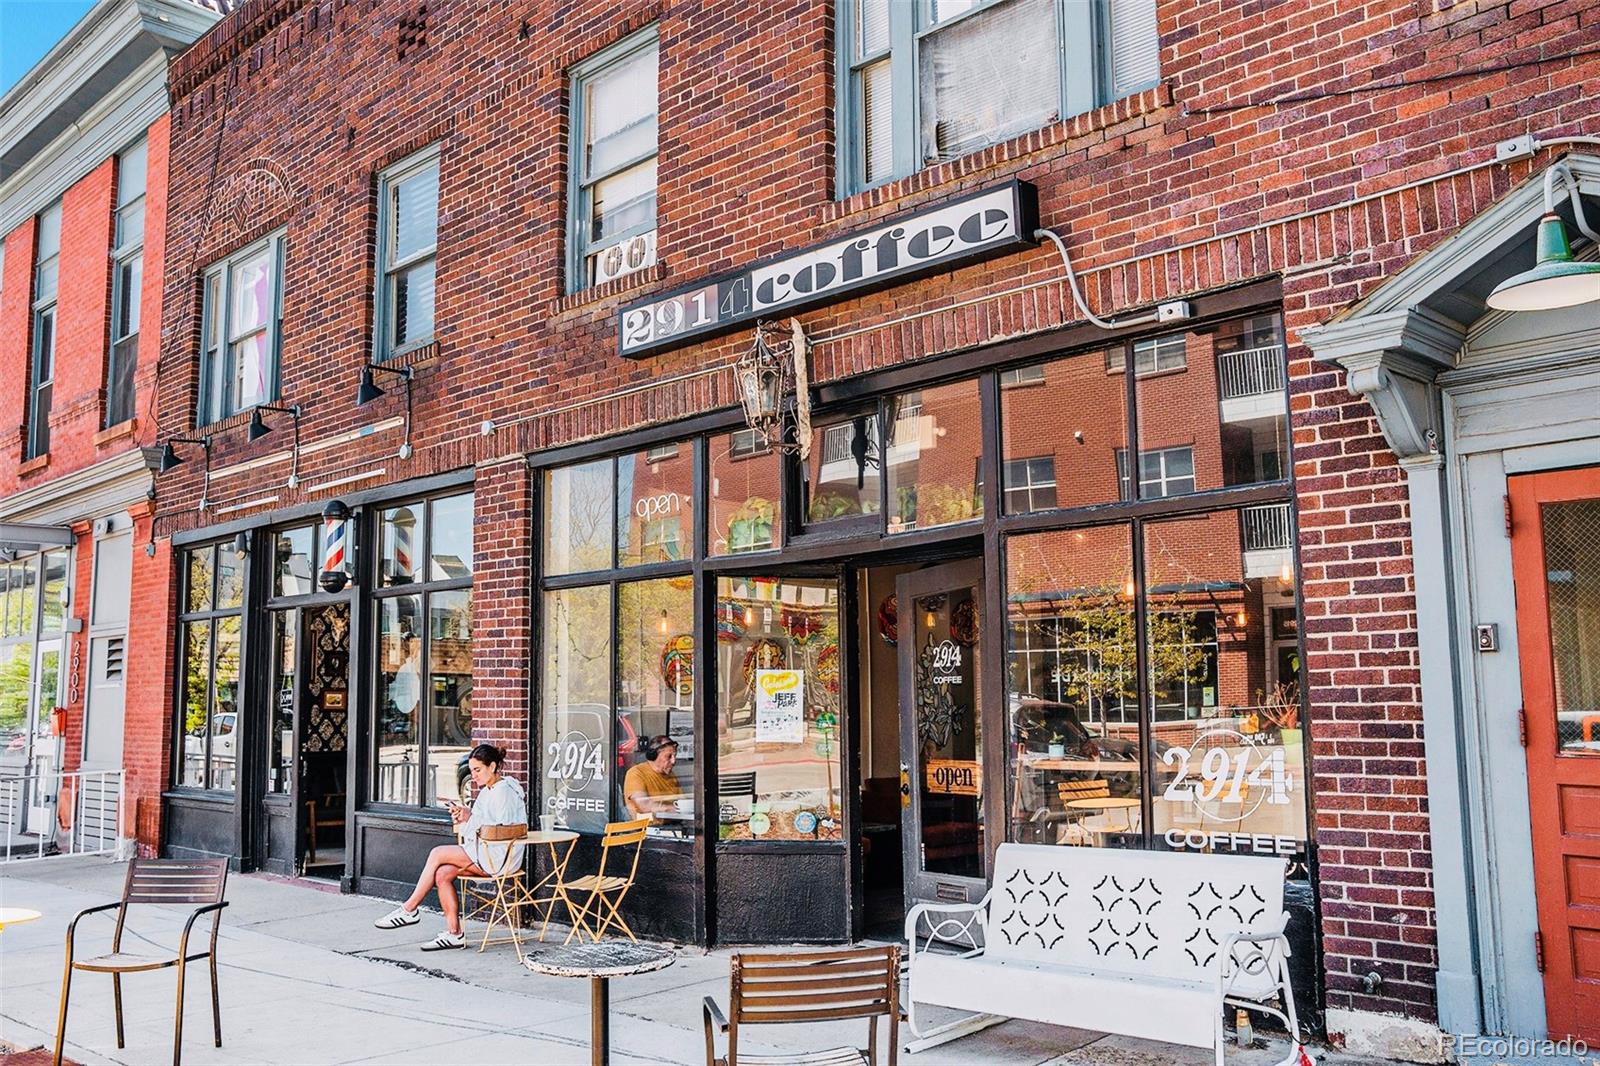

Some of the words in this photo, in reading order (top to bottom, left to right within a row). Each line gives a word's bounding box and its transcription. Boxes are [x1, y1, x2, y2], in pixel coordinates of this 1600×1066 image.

[625, 278, 749, 345] 2914
[756, 208, 1009, 306] coffee
[636, 492, 680, 522] open
[932, 645, 962, 668] 2914
[70, 641, 80, 704] 2900
[933, 675, 962, 685] COFFEE
[772, 693, 797, 703] JEFF
[547, 742, 605, 780] 2914
[935, 767, 974, 792] open
[1162, 746, 1294, 805] 2914
[547, 796, 605, 812] COFFEE
[1164, 828, 1297, 855] COFFEE
